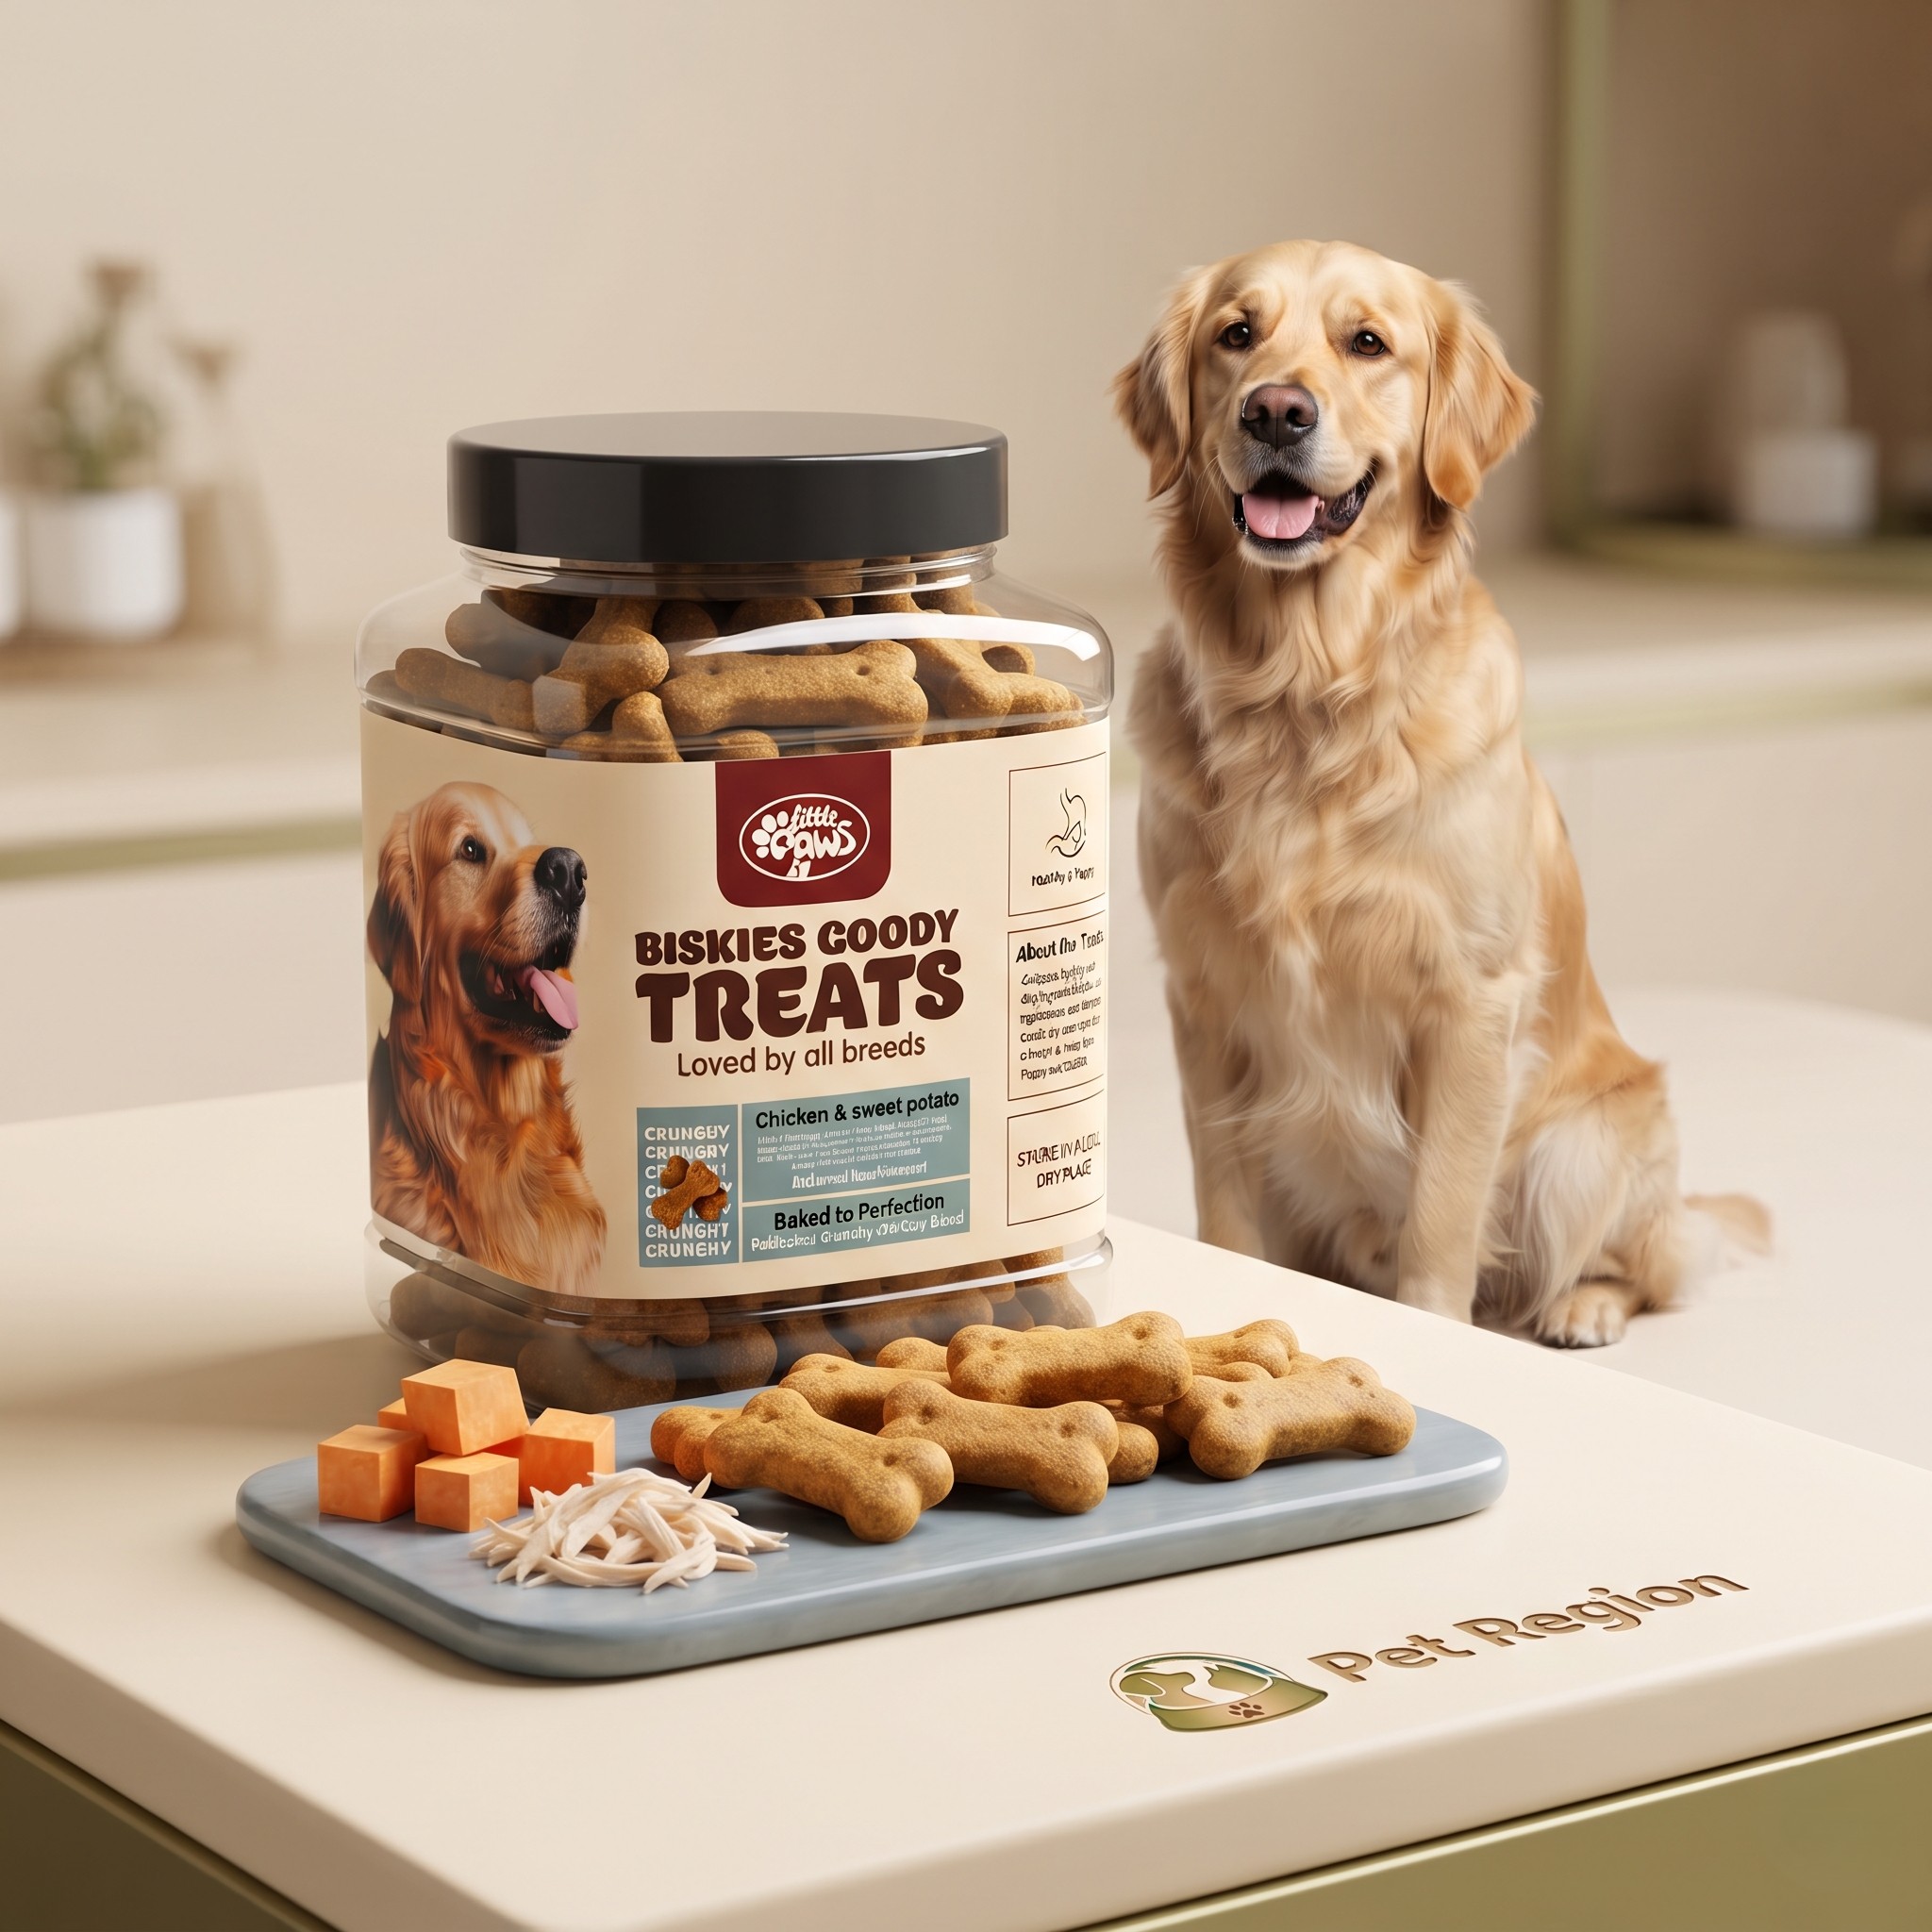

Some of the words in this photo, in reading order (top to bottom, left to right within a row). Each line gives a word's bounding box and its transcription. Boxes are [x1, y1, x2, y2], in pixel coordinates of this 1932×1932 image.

[635, 924, 807, 966] BISKIES
[817, 908, 959, 956] GOODY
[635, 949, 964, 1043] TREATS
[677, 1047, 756, 1077] Loved
[765, 1045, 796, 1075] by
[804, 1041, 833, 1067] all
[842, 1031, 925, 1063] breeds
[756, 1107, 829, 1129] Chicken
[834, 1104, 847, 1122] &
[852, 1097, 903, 1120] sweet
[907, 1091, 959, 1117] potato
[774, 1205, 830, 1230] Baked
[836, 1206, 854, 1224] to
[858, 1193, 944, 1221] Perfection
[1307, 1633, 1477, 1683] Pet
[1452, 1573, 1751, 1649] Region
